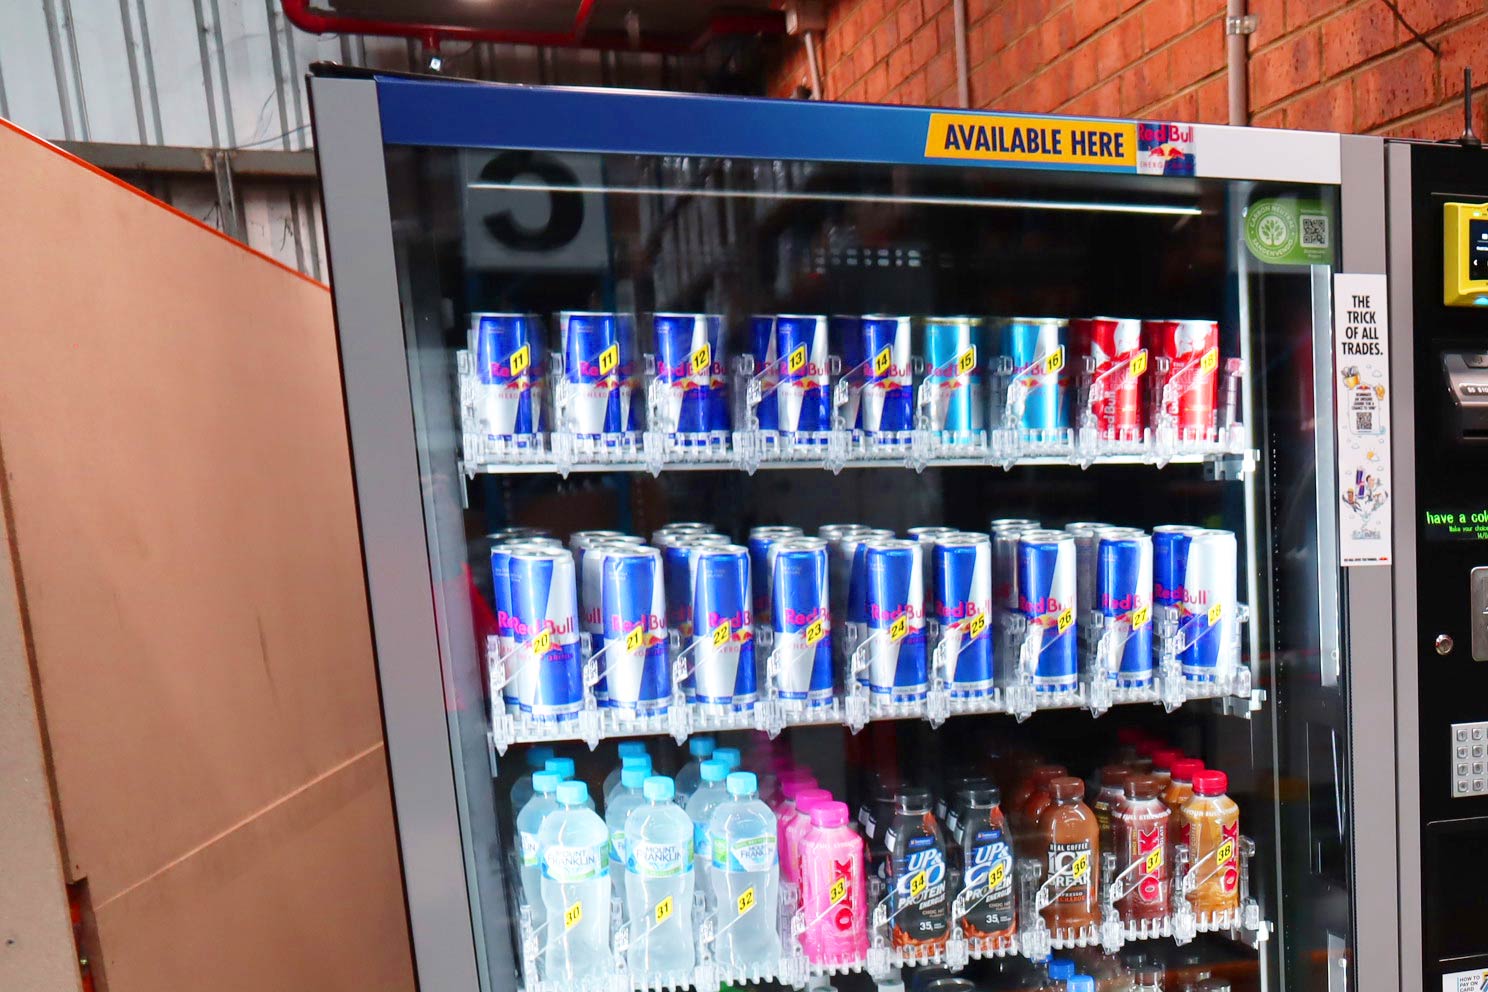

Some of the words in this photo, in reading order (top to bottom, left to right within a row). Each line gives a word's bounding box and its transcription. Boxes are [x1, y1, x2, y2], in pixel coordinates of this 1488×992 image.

[944, 122, 1062, 157] AVAILABLE
[1071, 130, 1125, 159] HERE
[1138, 124, 1167, 143] Red
[1169, 125, 1194, 143] Bull
[1352, 295, 1370, 308] THE
[1347, 311, 1376, 324] TRICK
[1345, 326, 1358, 339] OF
[1362, 327, 1379, 340] ALL
[1342, 342, 1383, 356] TRADES.
[513, 353, 524, 369] 11
[601, 353, 612, 368] 11
[693, 350, 706, 367] 12
[789, 351, 803, 369] 13
[875, 354, 888, 370] 14
[959, 353, 972, 370] 15
[1046, 355, 1059, 371] 16
[1132, 357, 1143, 371] 17
[808, 363, 829, 376] Bull
[927, 363, 952, 376] Red
[1426, 511, 1454, 525] have
[1459, 513, 1466, 523] a
[1154, 584, 1183, 600] Red
[1183, 590, 1207, 605] Bull
[935, 601, 963, 617] Red
[1019, 597, 1045, 613] Red
[1101, 594, 1133, 610] Red
[785, 607, 817, 625] Red
[871, 604, 902, 621] Red
[1059, 612, 1072, 629] 26
[1134, 610, 1147, 626] 27
[512, 615, 540, 636] Red
[545, 617, 574, 635] Bull
[612, 613, 647, 633] Red
[891, 618, 905, 637] 24
[971, 616, 985, 634] 25
[713, 627, 728, 645] 22
[807, 623, 822, 641] 23
[534, 634, 548, 653] 20
[628, 634, 640, 650] 21
[645, 846, 676, 854] MOUNT
[1067, 842, 1089, 851] COFFEE
[1217, 844, 1231, 861] 38
[546, 854, 595, 866] FRANKLIN
[1147, 850, 1160, 867] 37
[1073, 860, 1086, 874] 36
[911, 876, 925, 893] 34
[990, 869, 1003, 885] 35
[830, 880, 844, 898] 33
[897, 880, 945, 907] PROTEIN
[738, 891, 753, 909] 32
[565, 907, 580, 926] 30
[656, 902, 669, 920] 31
